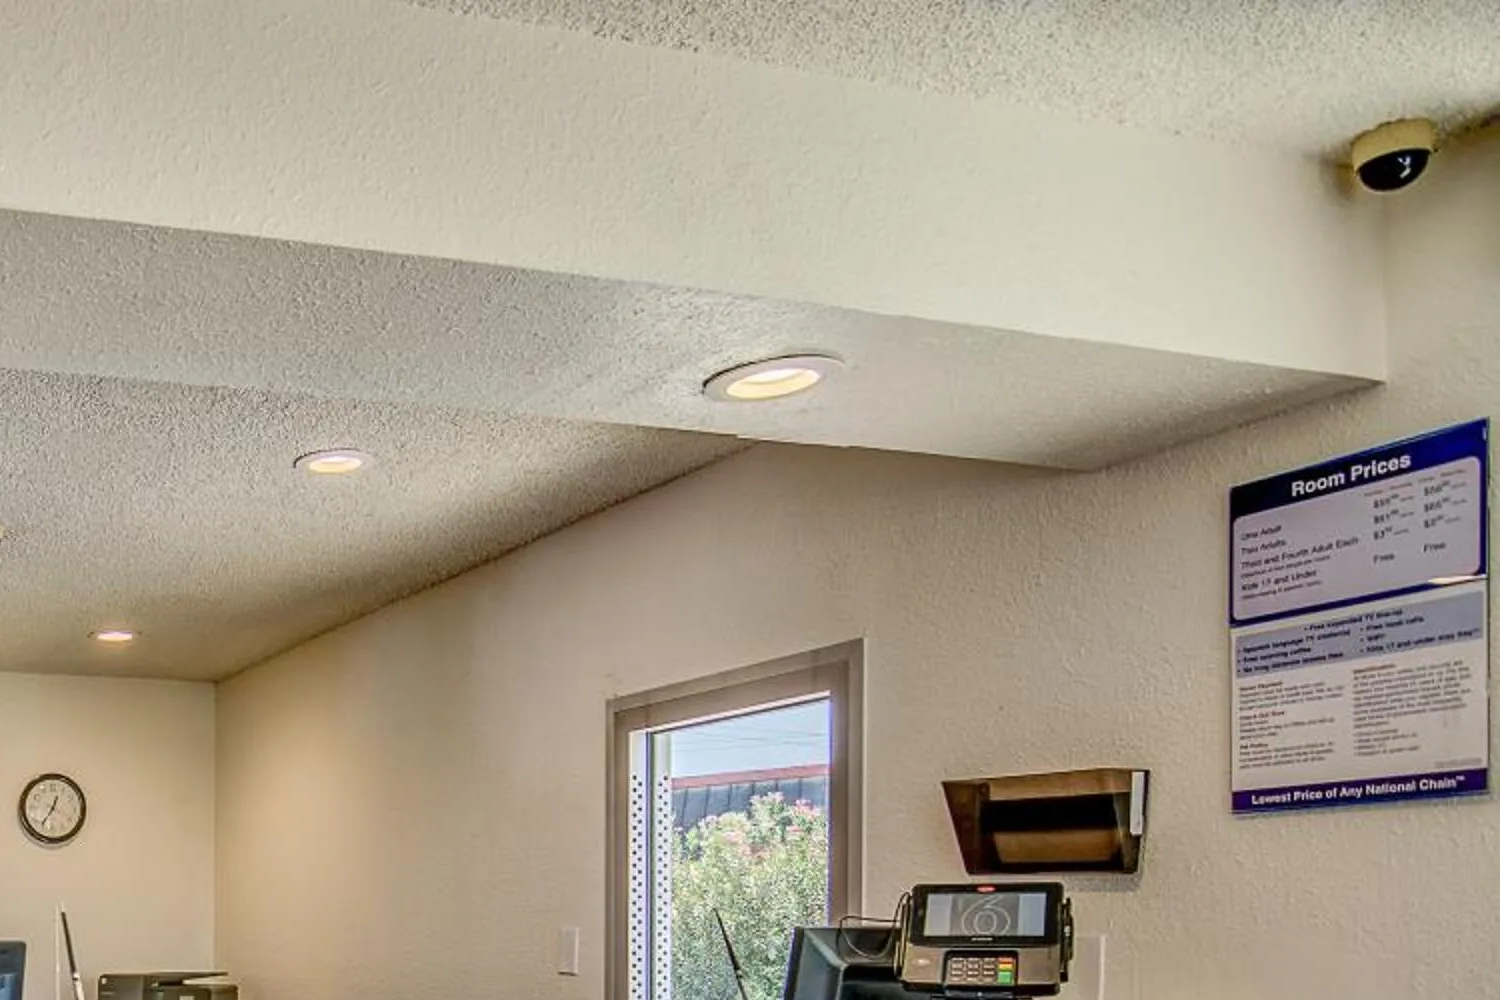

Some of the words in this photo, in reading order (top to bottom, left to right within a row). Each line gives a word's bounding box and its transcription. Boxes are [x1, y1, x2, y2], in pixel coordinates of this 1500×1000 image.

[1290, 472, 1345, 497] Room
[1350, 454, 1412, 481] Prices
[1251, 793, 1291, 805] Lowest
[1293, 791, 1323, 802] Price
[1325, 788, 1337, 799] of
[1340, 786, 1363, 799] Any
[1365, 780, 1416, 796] National
[961, 894, 1011, 936] 6
